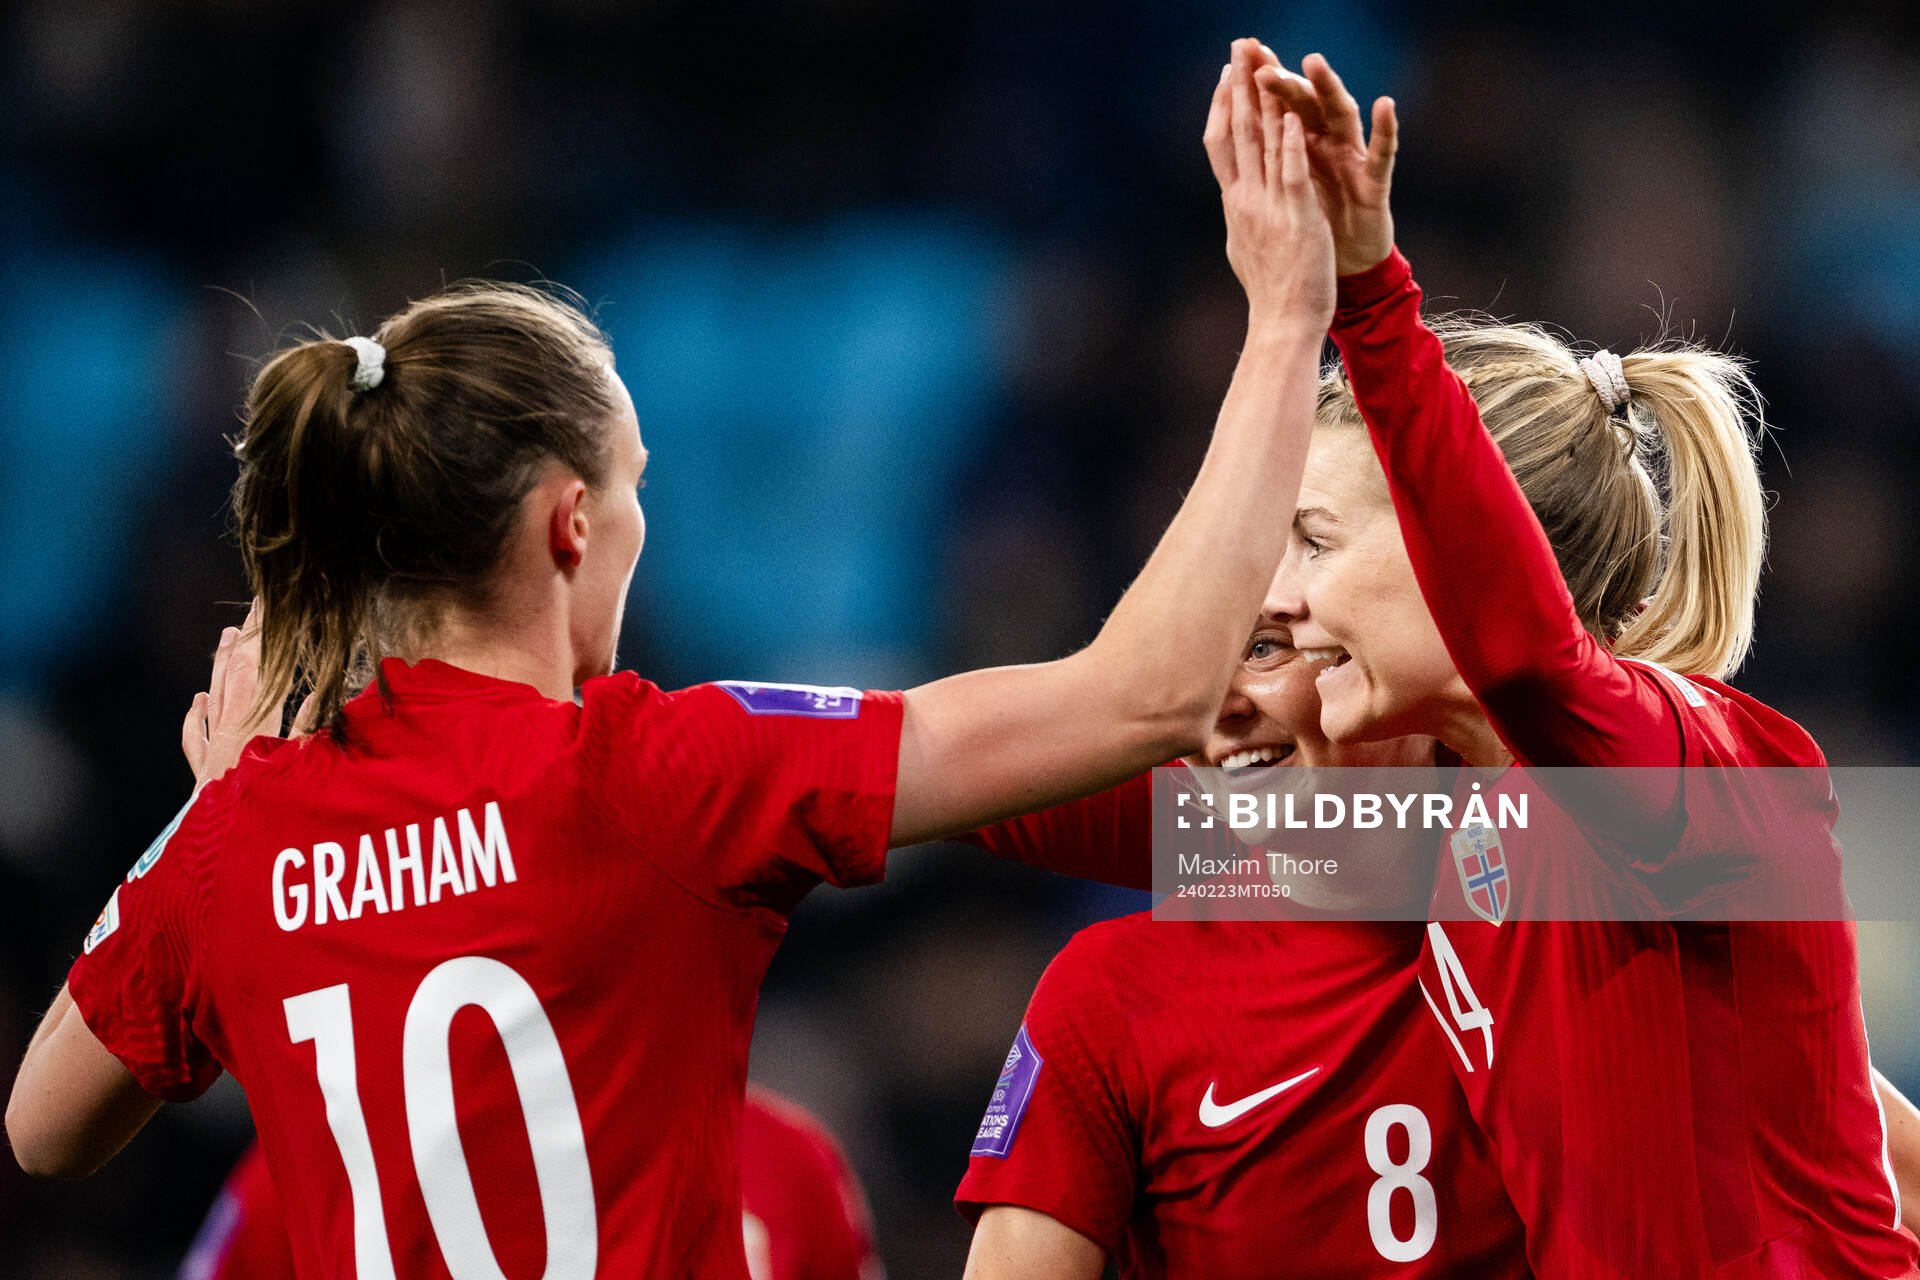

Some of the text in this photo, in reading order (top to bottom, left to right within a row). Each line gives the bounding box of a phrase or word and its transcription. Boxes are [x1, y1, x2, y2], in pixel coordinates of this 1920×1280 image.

[272, 801, 517, 932] GRAHAM
[282, 956, 598, 1280] 10
[981, 1114, 1009, 1127] ATIONS
[1364, 1103, 1438, 1263] 8
